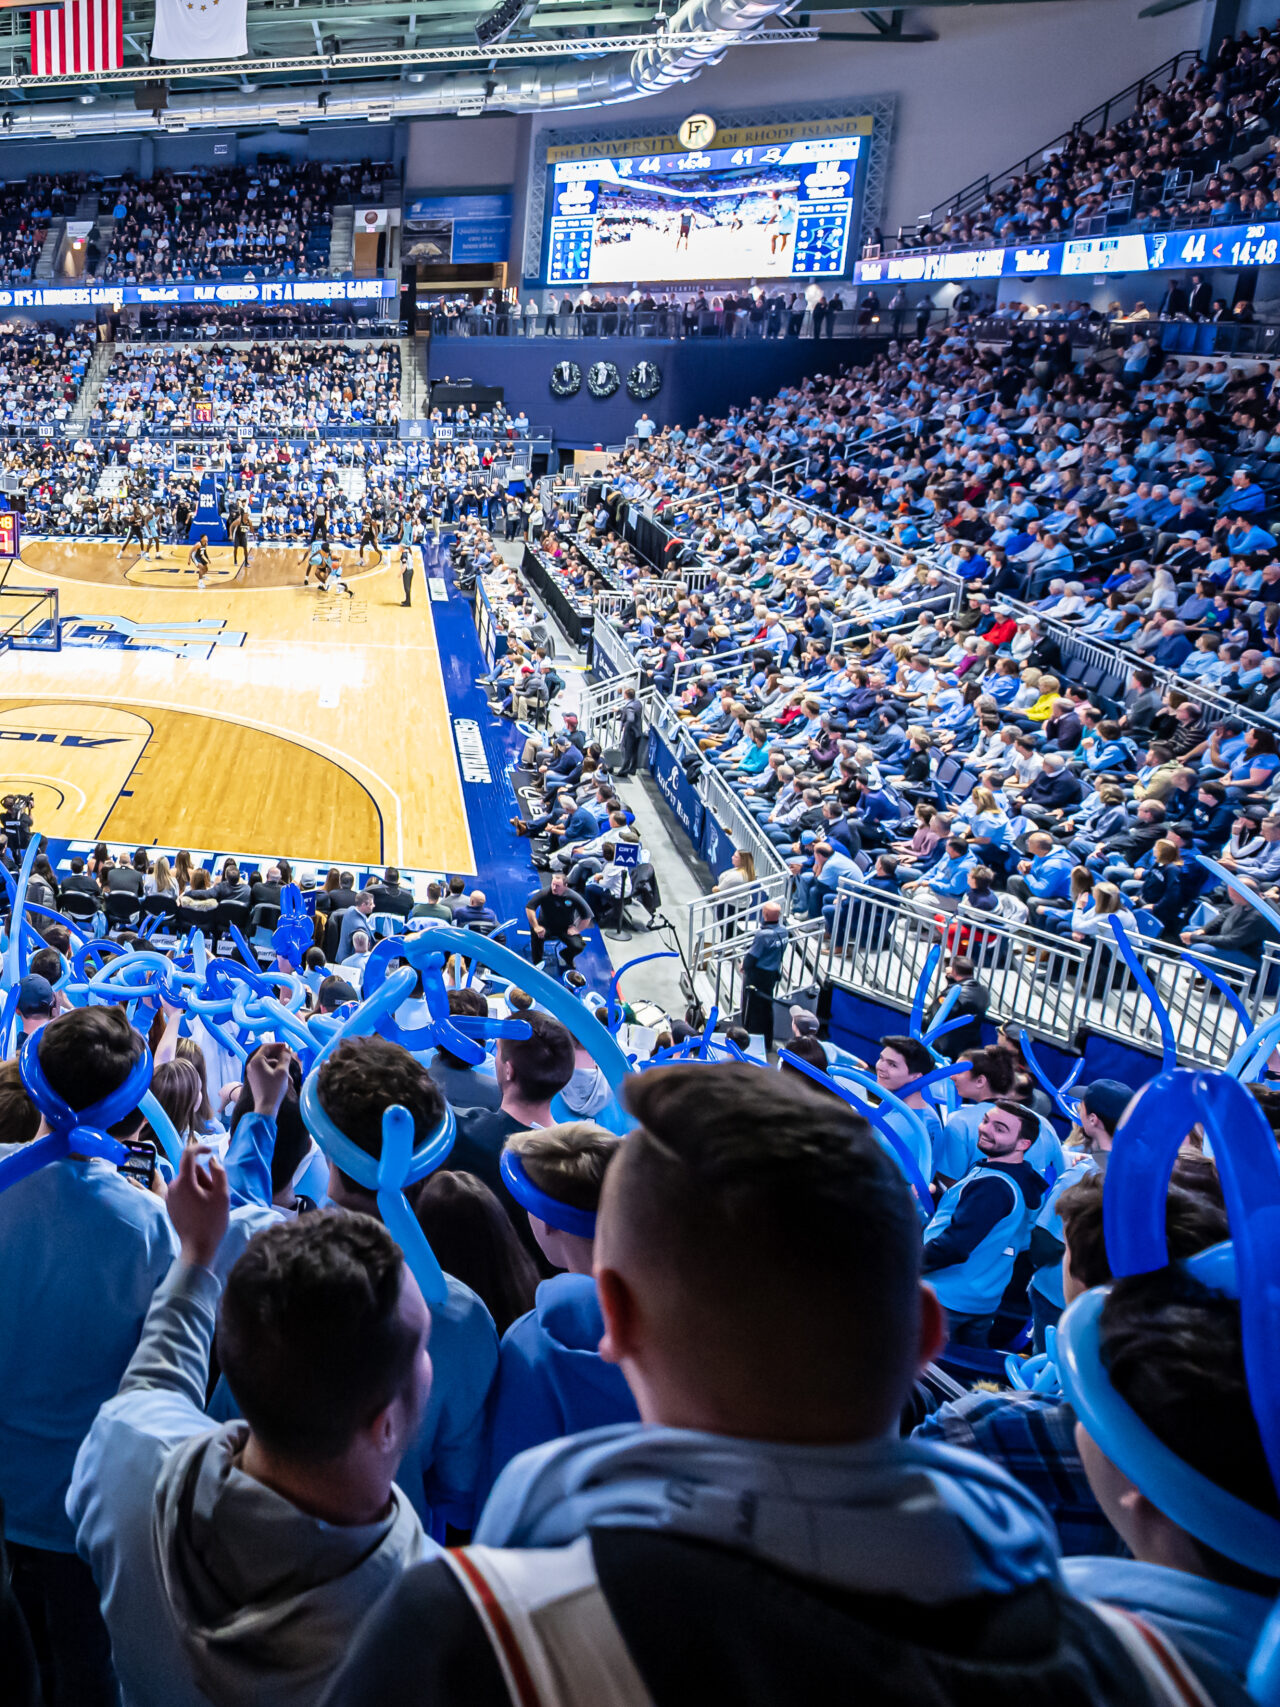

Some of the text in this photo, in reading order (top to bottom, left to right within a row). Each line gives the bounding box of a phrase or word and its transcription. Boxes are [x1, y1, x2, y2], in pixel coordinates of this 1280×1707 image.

[553, 150, 576, 160] THE
[580, 138, 676, 157] UNIVERSITY
[722, 133, 738, 144] OF
[745, 127, 795, 142] RHODE
[802, 121, 858, 137] ISLAND
[638, 157, 661, 173] 44
[730, 148, 753, 165] 41
[1181, 234, 1278, 266] 44 14:48
[261, 284, 283, 300] IT'S
[283, 283, 294, 299] A
[40, 427, 53, 435] 107
[239, 427, 253, 437] 108
[437, 427, 452, 437] 109
[615, 855, 636, 864] AA
